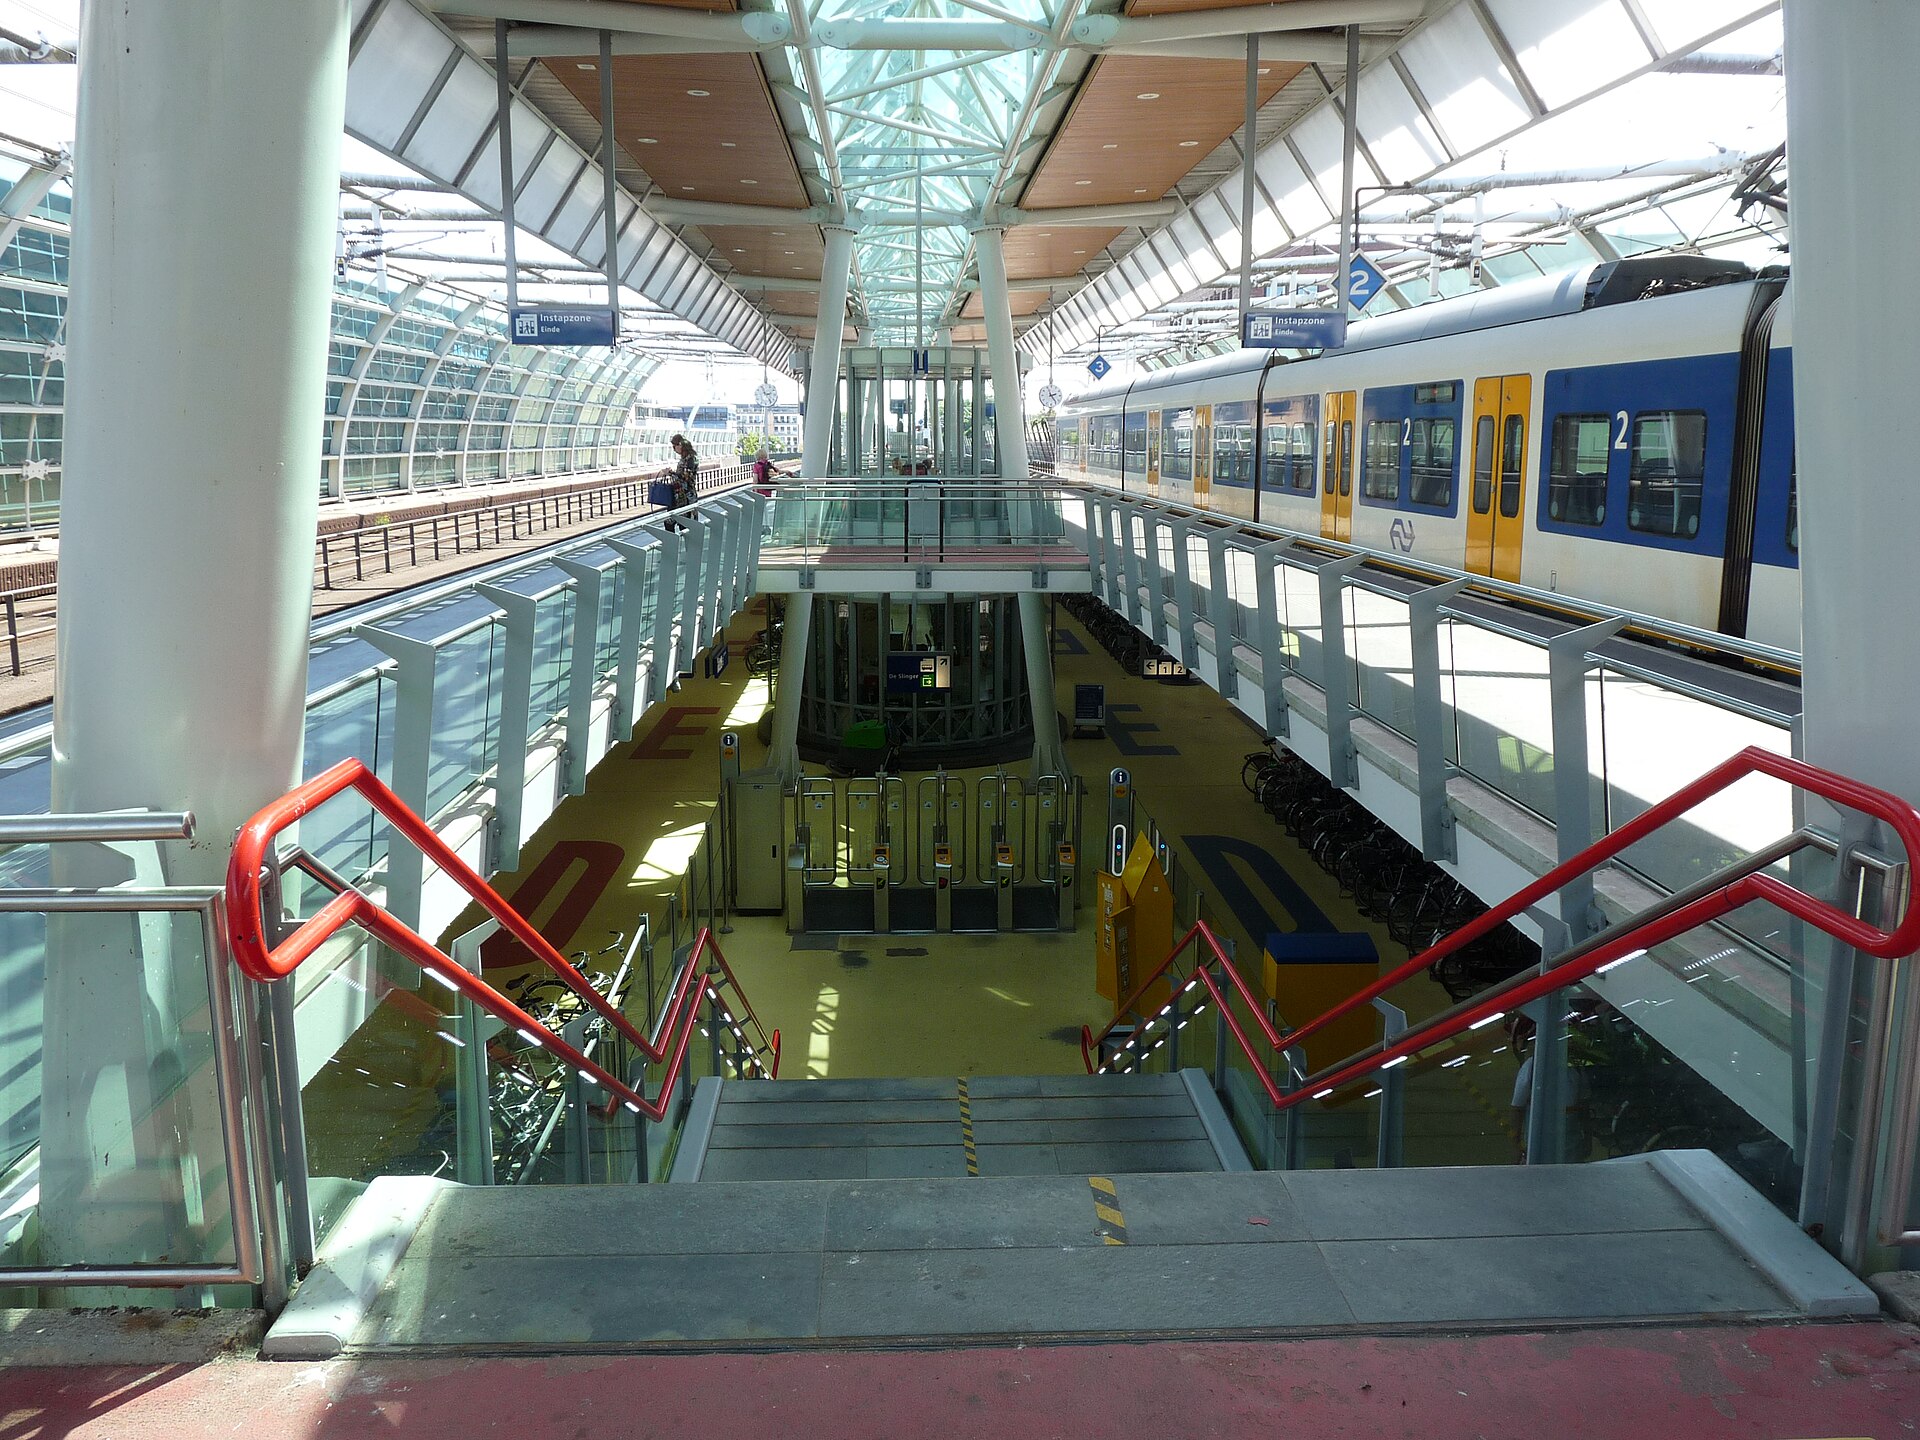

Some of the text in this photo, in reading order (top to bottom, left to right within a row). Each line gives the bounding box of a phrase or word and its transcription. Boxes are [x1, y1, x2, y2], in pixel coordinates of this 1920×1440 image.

[1349, 269, 1370, 296] 2
[540, 313, 592, 324] Instapzone
[1275, 316, 1326, 327] Instapzone
[540, 325, 561, 333] Einde
[1275, 328, 1294, 336] Einde
[1094, 360, 1105, 373] 3
[1402, 417, 1411, 447] 2
[1614, 410, 1629, 450] 2
[1177, 666, 1183, 674] 2
